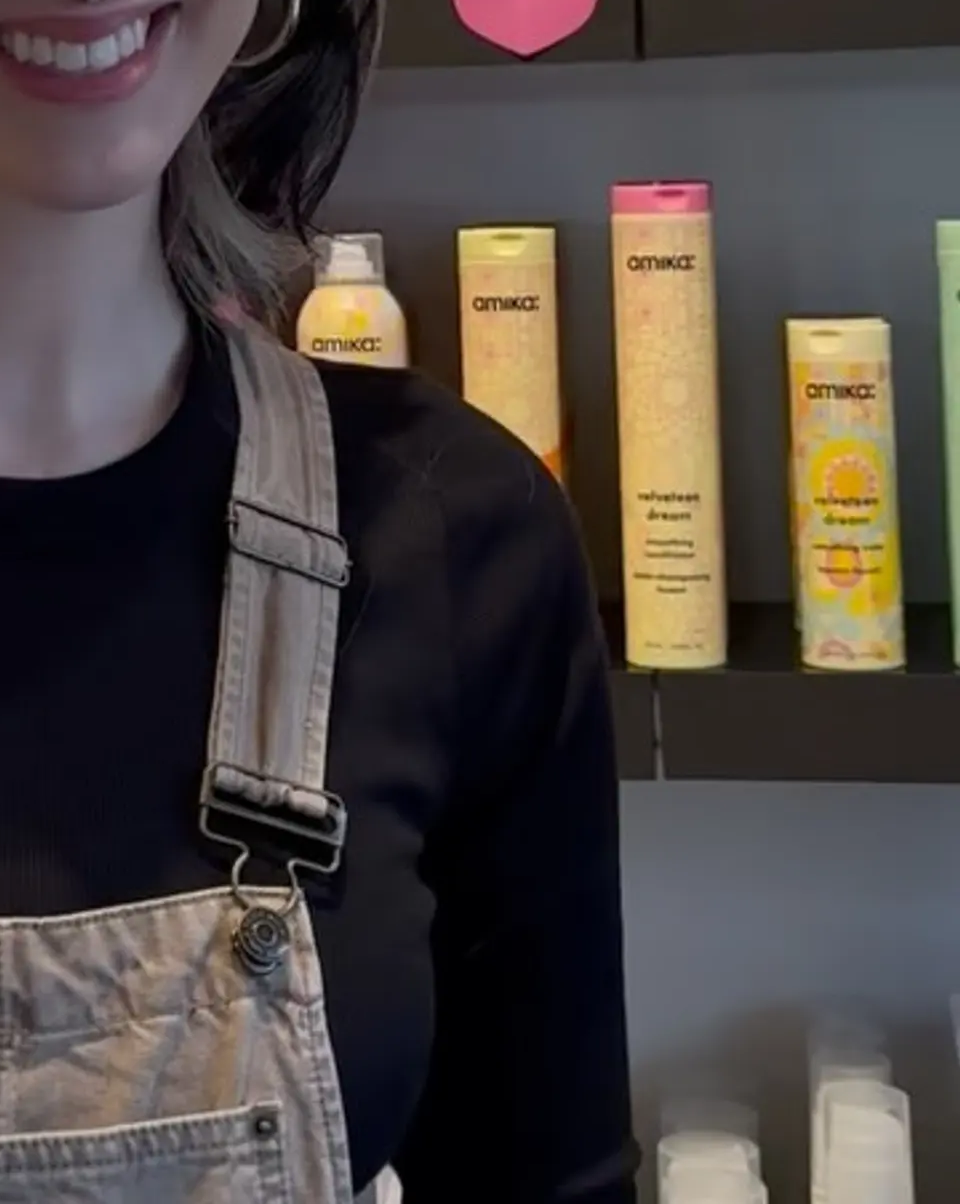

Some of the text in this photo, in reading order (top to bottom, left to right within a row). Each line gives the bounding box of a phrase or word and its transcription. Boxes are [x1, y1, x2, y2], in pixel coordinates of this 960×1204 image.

[627, 254, 697, 273] amika:
[472, 295, 540, 312] amika:
[311, 336, 382, 353] amika:
[805, 383, 876, 400] amika:
